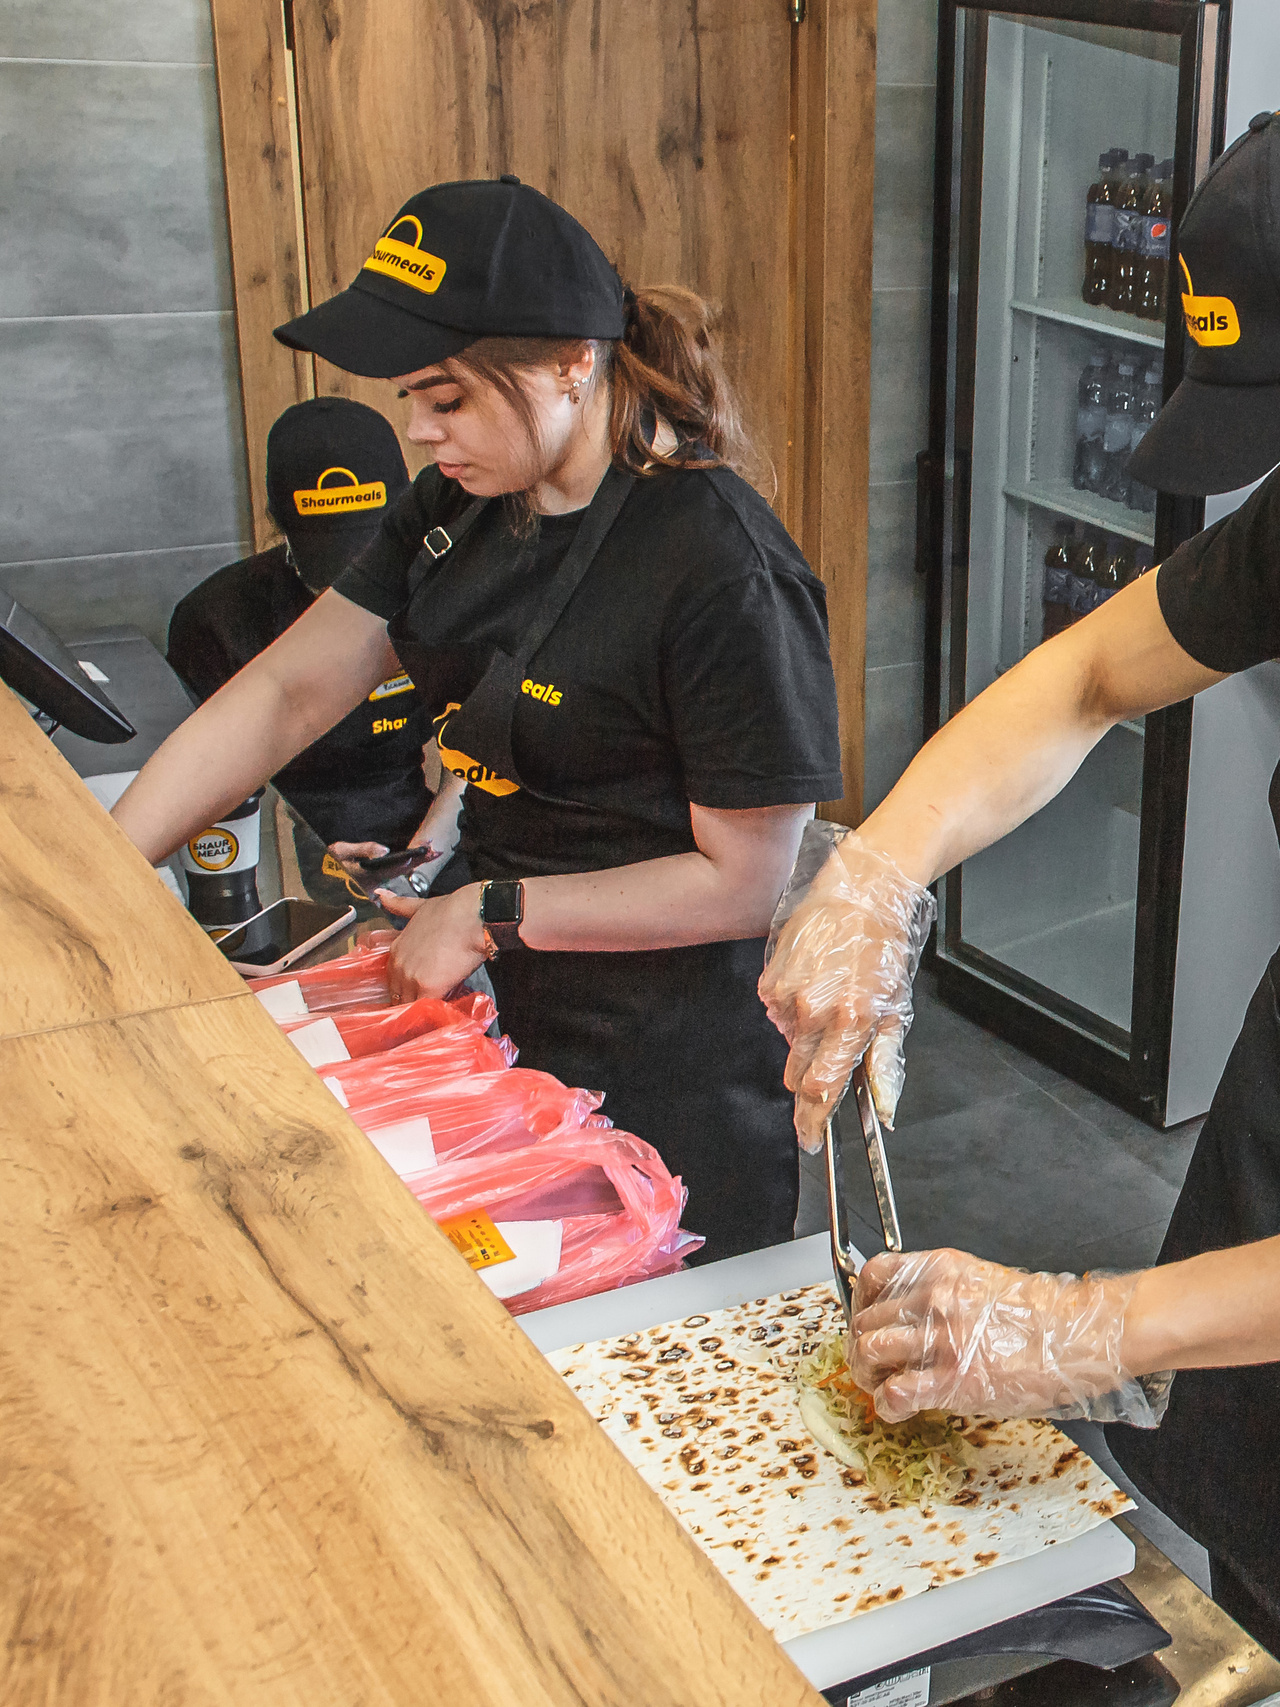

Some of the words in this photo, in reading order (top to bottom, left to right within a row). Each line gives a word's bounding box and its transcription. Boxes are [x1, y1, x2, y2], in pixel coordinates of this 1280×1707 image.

[301, 490, 382, 508] Shaurmeals
[193, 839, 229, 851] SHAUR
[197, 845, 233, 858] MEALS
